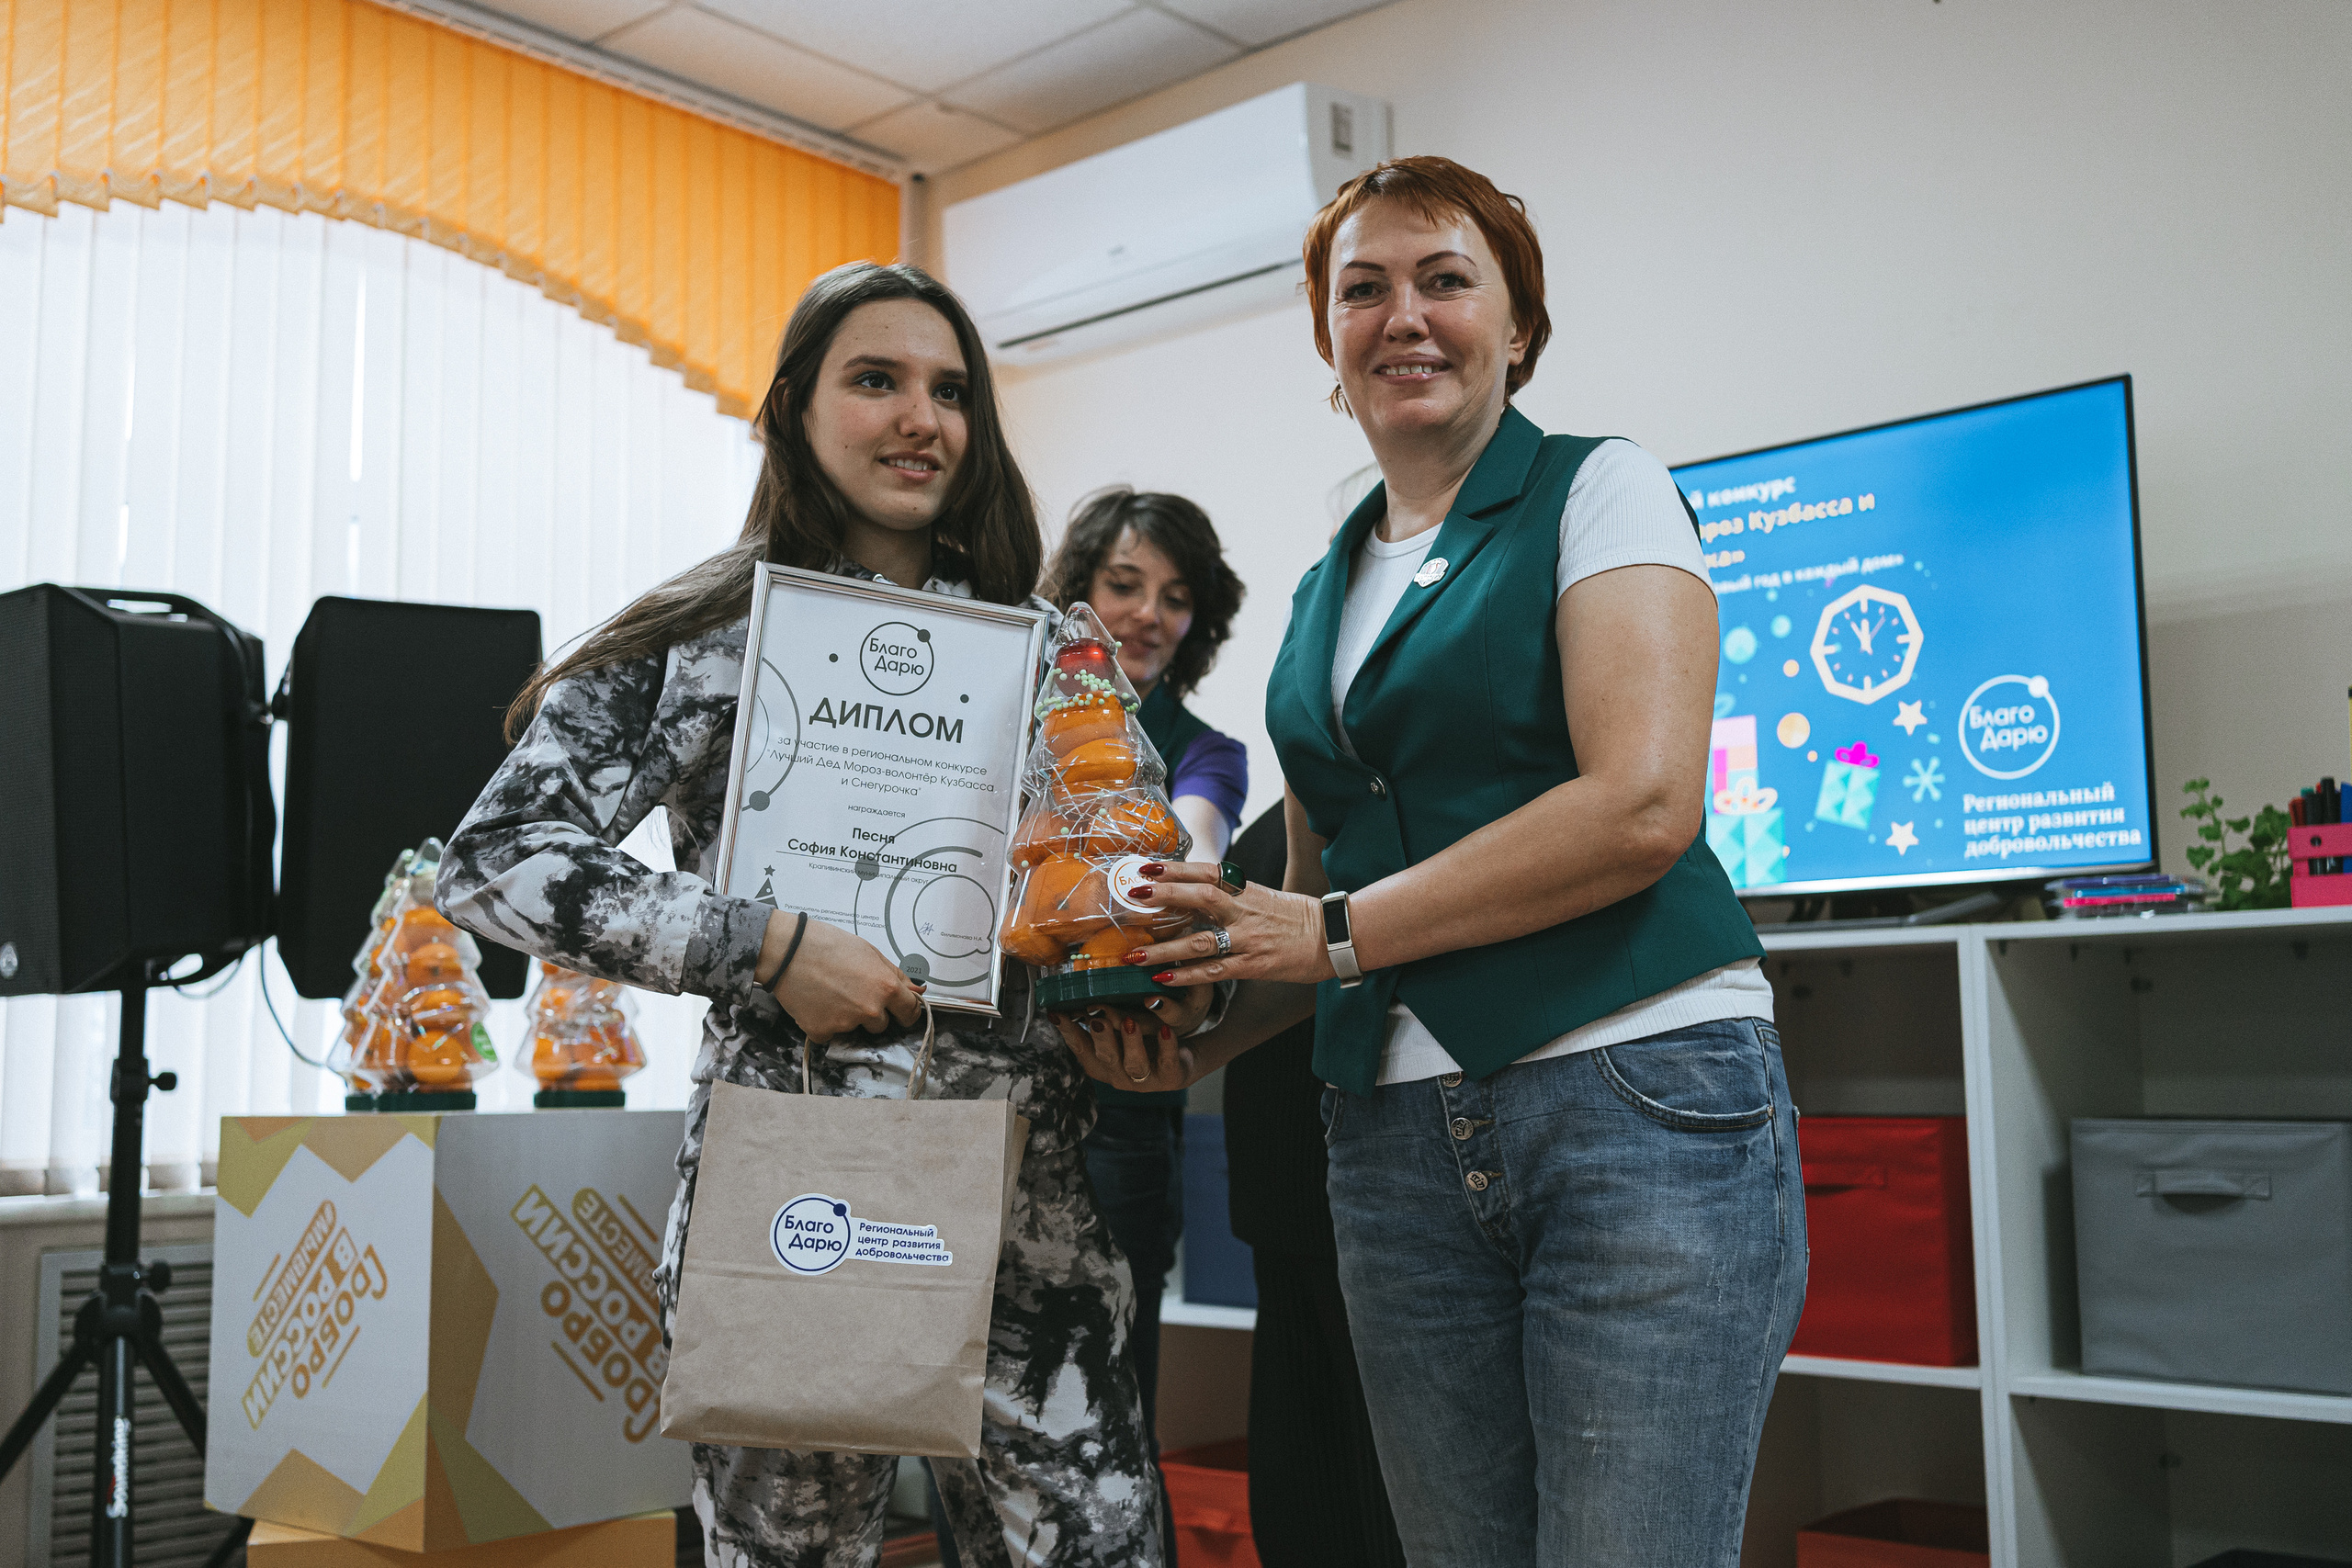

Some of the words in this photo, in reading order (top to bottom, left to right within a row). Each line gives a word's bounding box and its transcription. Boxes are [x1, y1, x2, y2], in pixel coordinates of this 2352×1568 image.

[1706, 477, 1795, 507] конкурс
[1747, 497, 1853, 534] Кузбасса
[1858, 492, 1875, 512] и
[869, 637, 918, 659] Благо
[874, 655, 924, 677] Дарю
[808, 696, 964, 744] ДИПЛОМ
[1969, 705, 2035, 729] Благо
[1980, 724, 2048, 752] Дарю
[777, 737, 791, 746] за
[794, 739, 840, 752] участие
[842, 746, 849, 754] в
[851, 747, 933, 767] региональном
[934, 761, 988, 775] конкурсе
[766, 749, 814, 764] "Лучший
[815, 756, 841, 770] Дед
[843, 760, 938, 784] Мороз-волонтёр
[940, 775, 994, 792] Кузбасса
[841, 777, 848, 785] и
[851, 777, 922, 795] Снегурочка"
[1962, 781, 2115, 813] Региональный
[847, 804, 906, 818] награждается
[1963, 815, 2025, 838] центр
[2028, 807, 2125, 835] развития
[852, 827, 896, 844] Песня
[1964, 829, 2142, 860] добровольчества
[787, 838, 836, 855] София
[840, 845, 957, 873] Константиновна
[906, 965, 922, 974] 2021
[784, 1214, 834, 1234] Благо
[859, 1222, 934, 1237] Региональный
[332, 1231, 356, 1273] В
[788, 1233, 842, 1252] Дарю
[855, 1247, 949, 1262] добровольчества
[857, 1235, 888, 1247] центр
[892, 1238, 941, 1250] развития
[514, 1191, 650, 1351] РОССИИ
[243, 1263, 336, 1427] РОССИИ
